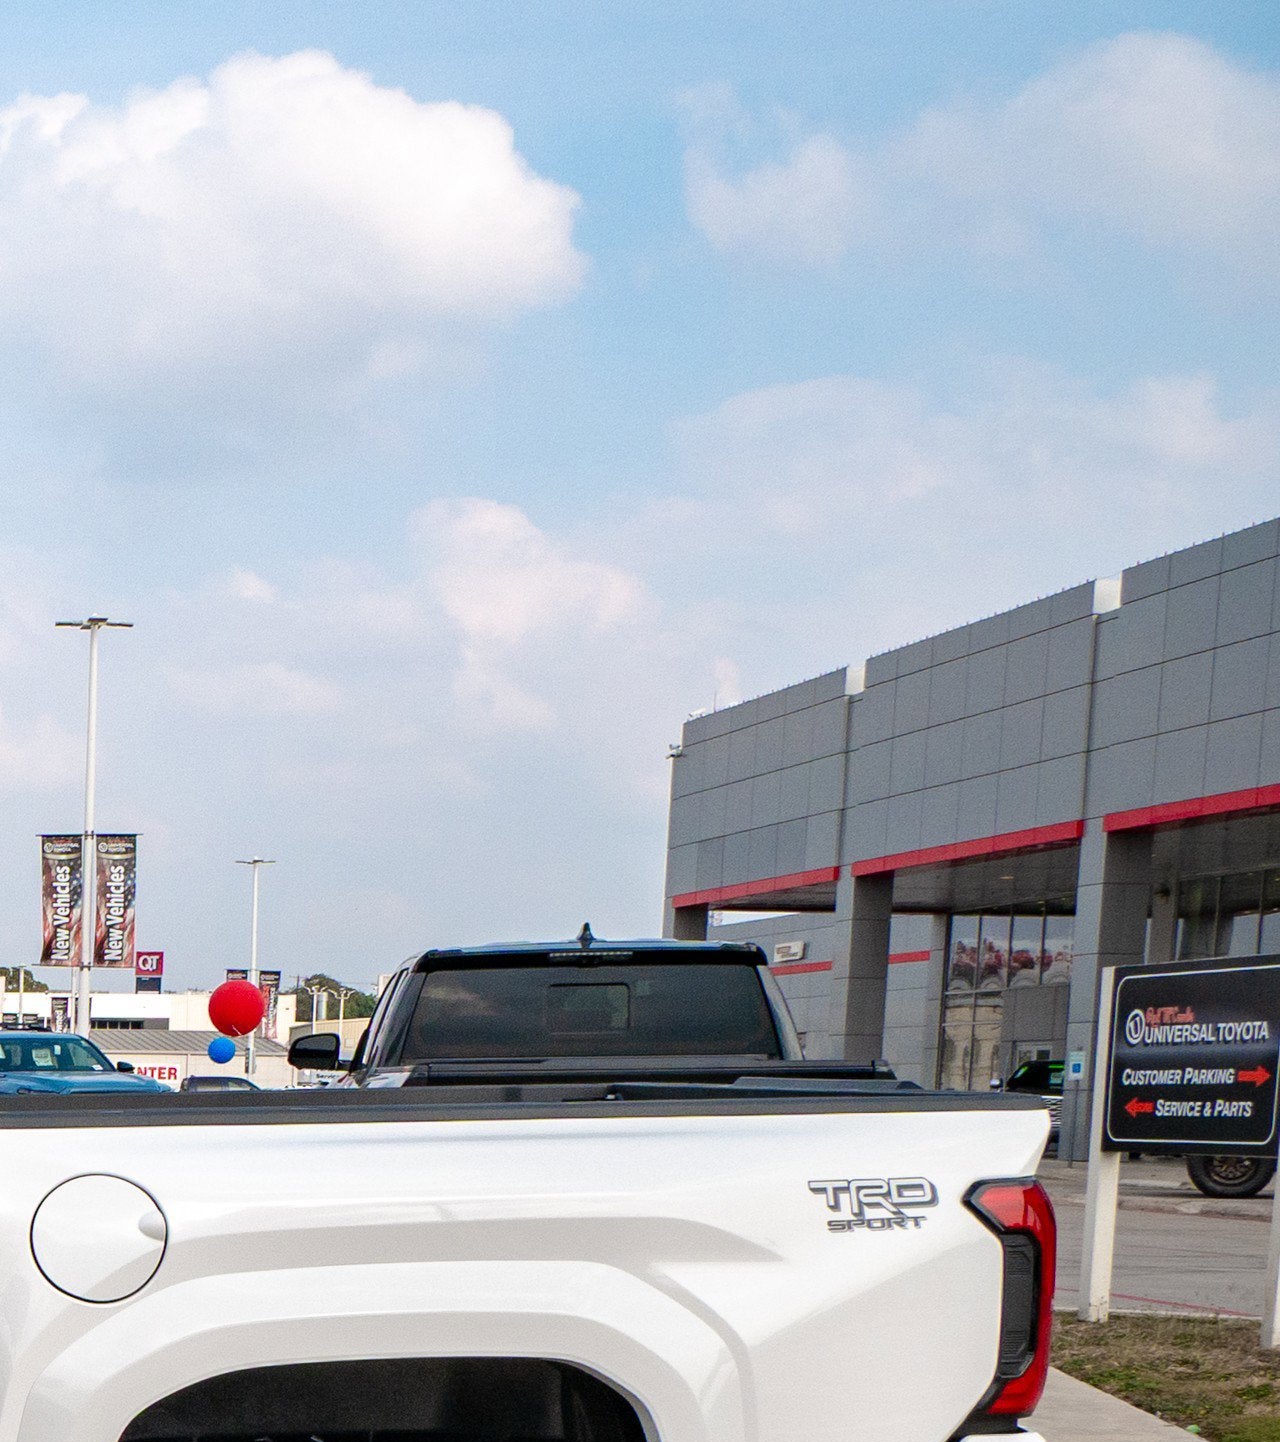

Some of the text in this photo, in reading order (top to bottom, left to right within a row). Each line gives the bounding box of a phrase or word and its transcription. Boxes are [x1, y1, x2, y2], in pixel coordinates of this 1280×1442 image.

[51, 865, 71, 960] New Vehicles
[104, 865, 125, 960] New Vehicles
[138, 955, 160, 971] QT
[1144, 1021, 1269, 1044] UNIVERSAL TOYOTA
[1122, 1067, 1235, 1085] CUSTOMER PARKING
[1155, 1099, 1253, 1117] SERVICE & PARTS
[808, 1177, 939, 1218] TRD
[827, 1216, 927, 1233] SPORT
